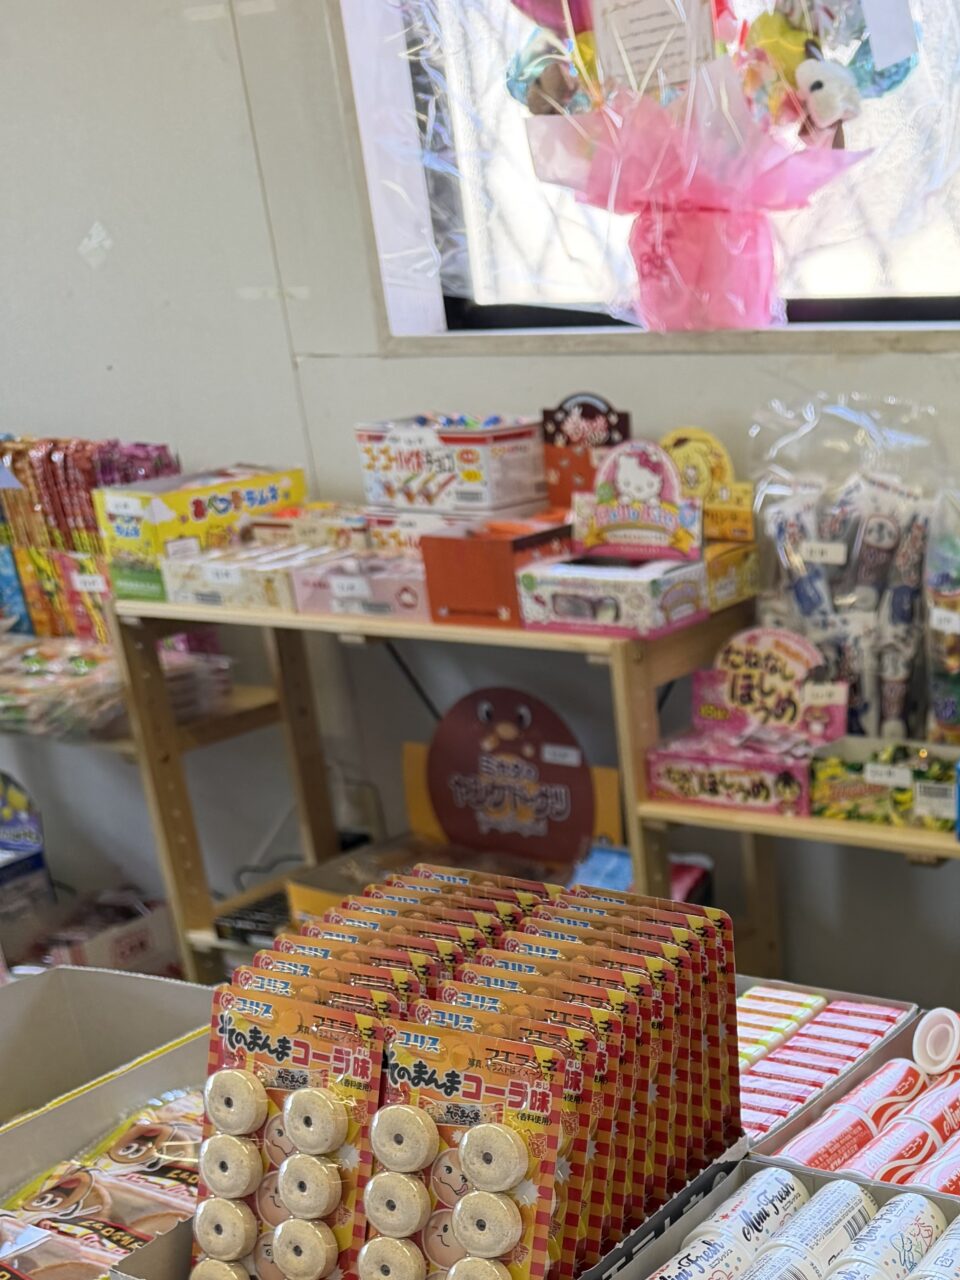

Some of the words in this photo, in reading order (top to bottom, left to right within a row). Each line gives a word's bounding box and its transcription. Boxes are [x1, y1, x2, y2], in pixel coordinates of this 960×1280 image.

[254, 975, 291, 996] コリス
[236, 998, 274, 1020] コリス
[432, 1011, 476, 1032] コリス
[398, 1032, 441, 1053] コリス
[486, 1048, 558, 1072] フエラムネ
[387, 1050, 554, 1116] そのまんまコーラ味
[742, 1206, 771, 1242] Mini
[762, 1177, 796, 1216] Fresh
[678, 1239, 725, 1274] Fresh
